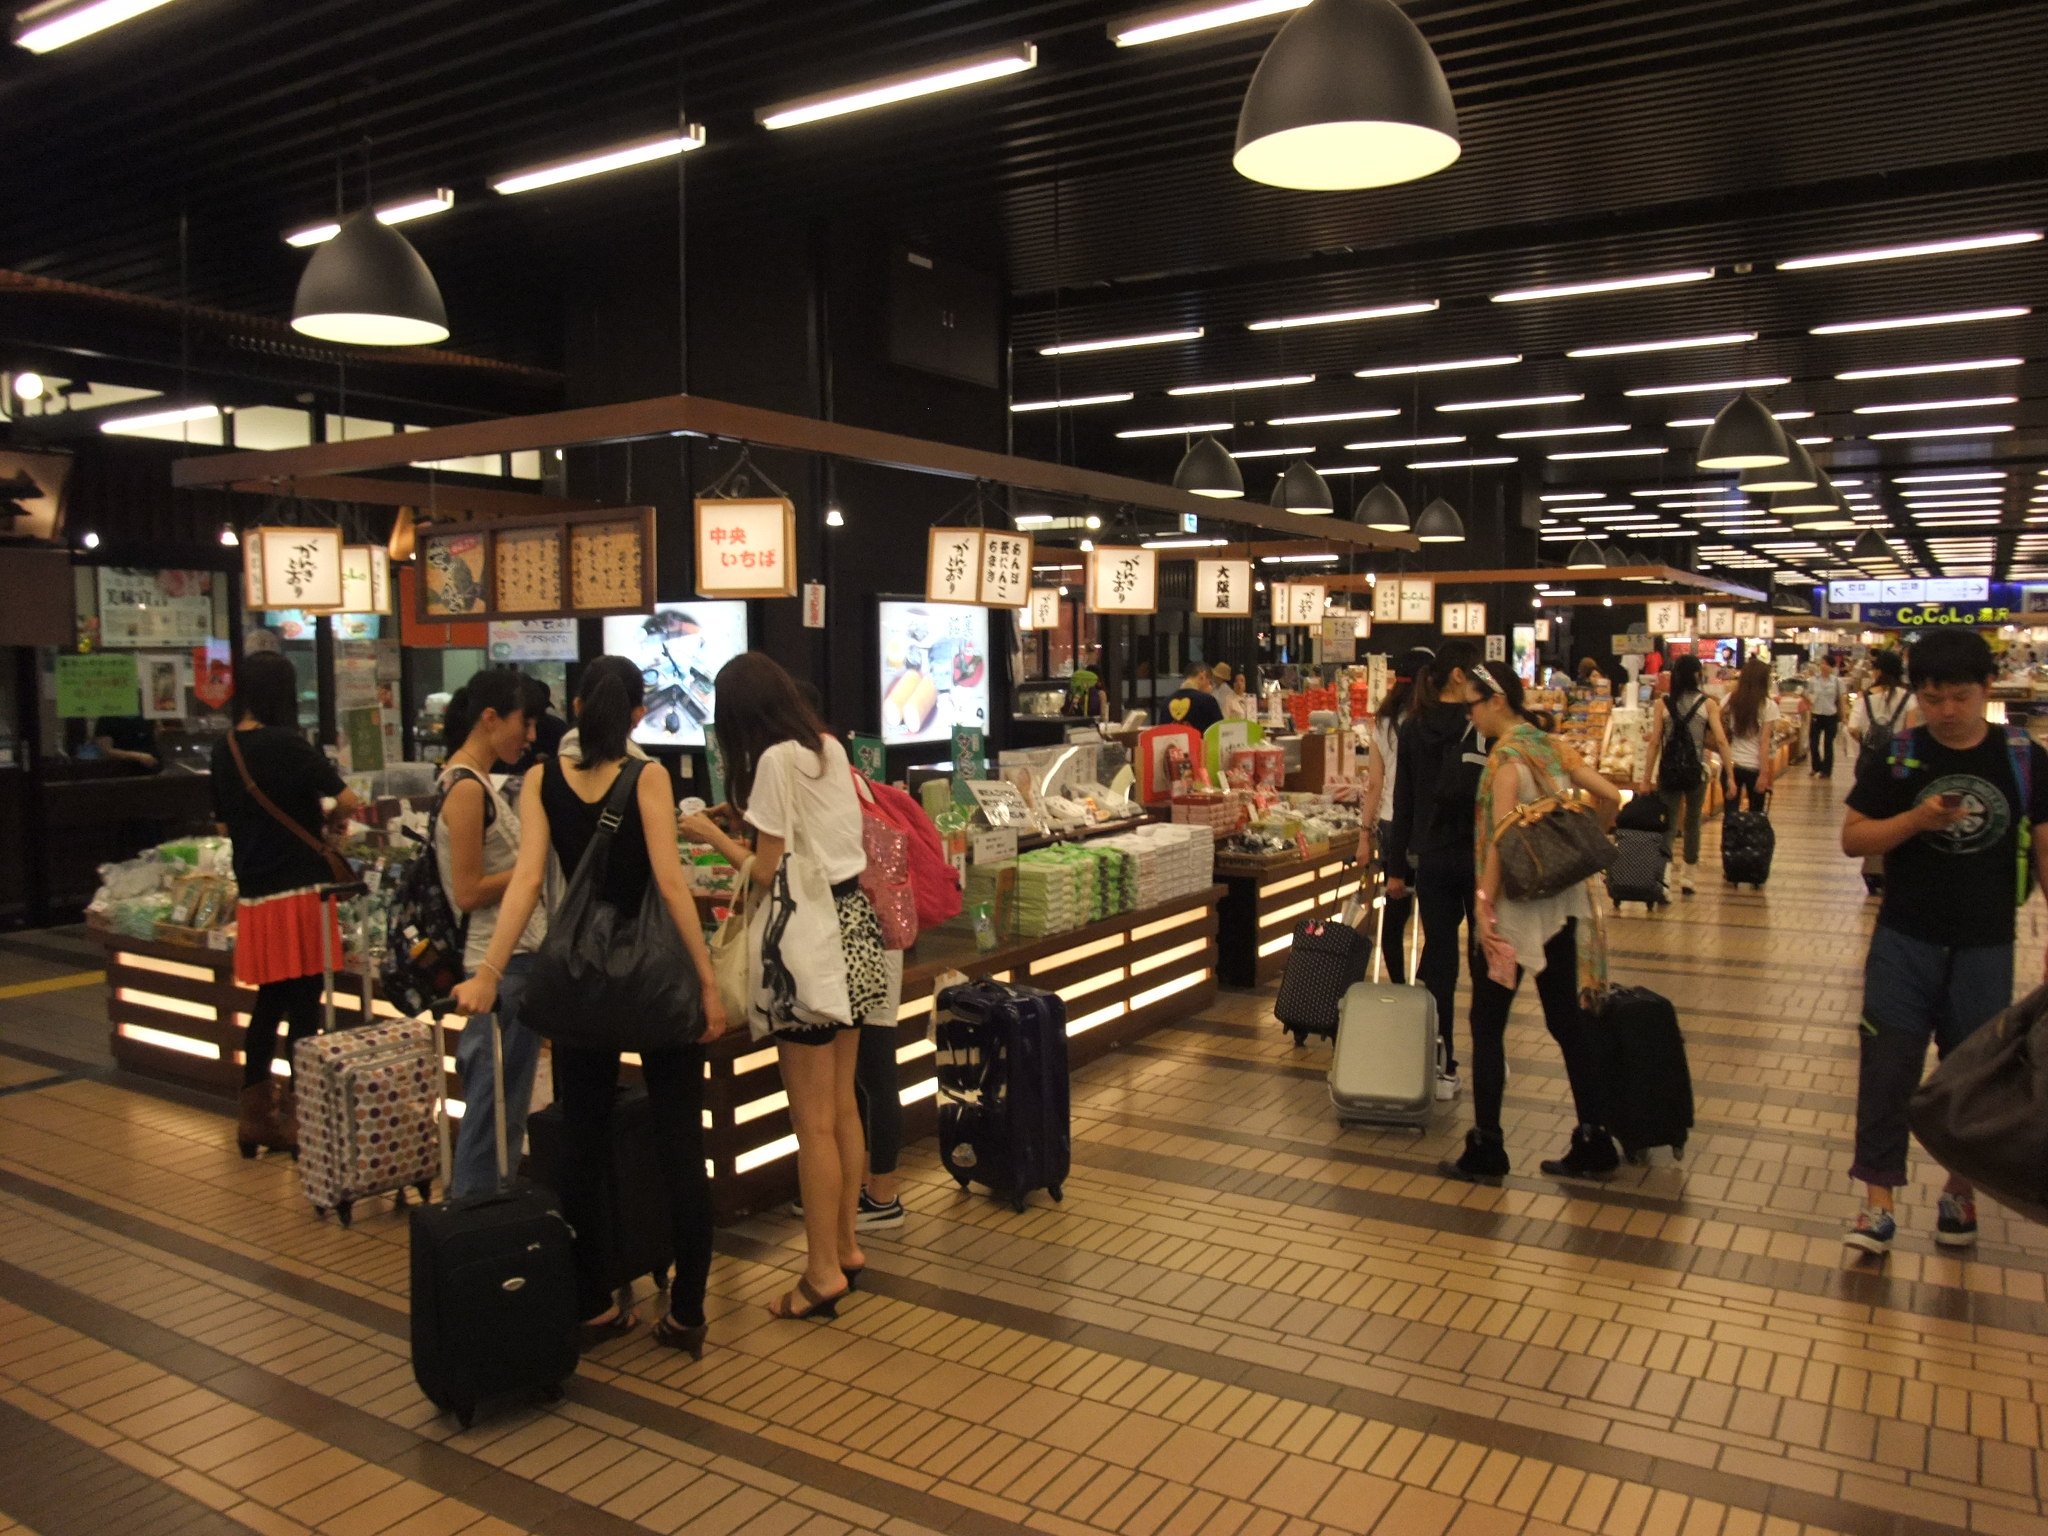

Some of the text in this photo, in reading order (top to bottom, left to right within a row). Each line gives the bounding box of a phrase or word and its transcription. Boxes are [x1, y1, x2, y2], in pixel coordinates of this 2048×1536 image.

[709, 527, 747, 545] 中央
[721, 549, 776, 568] いちば
[1216, 565, 1230, 609] 大阪屋
[1896, 607, 1975, 625] CoCoLo
